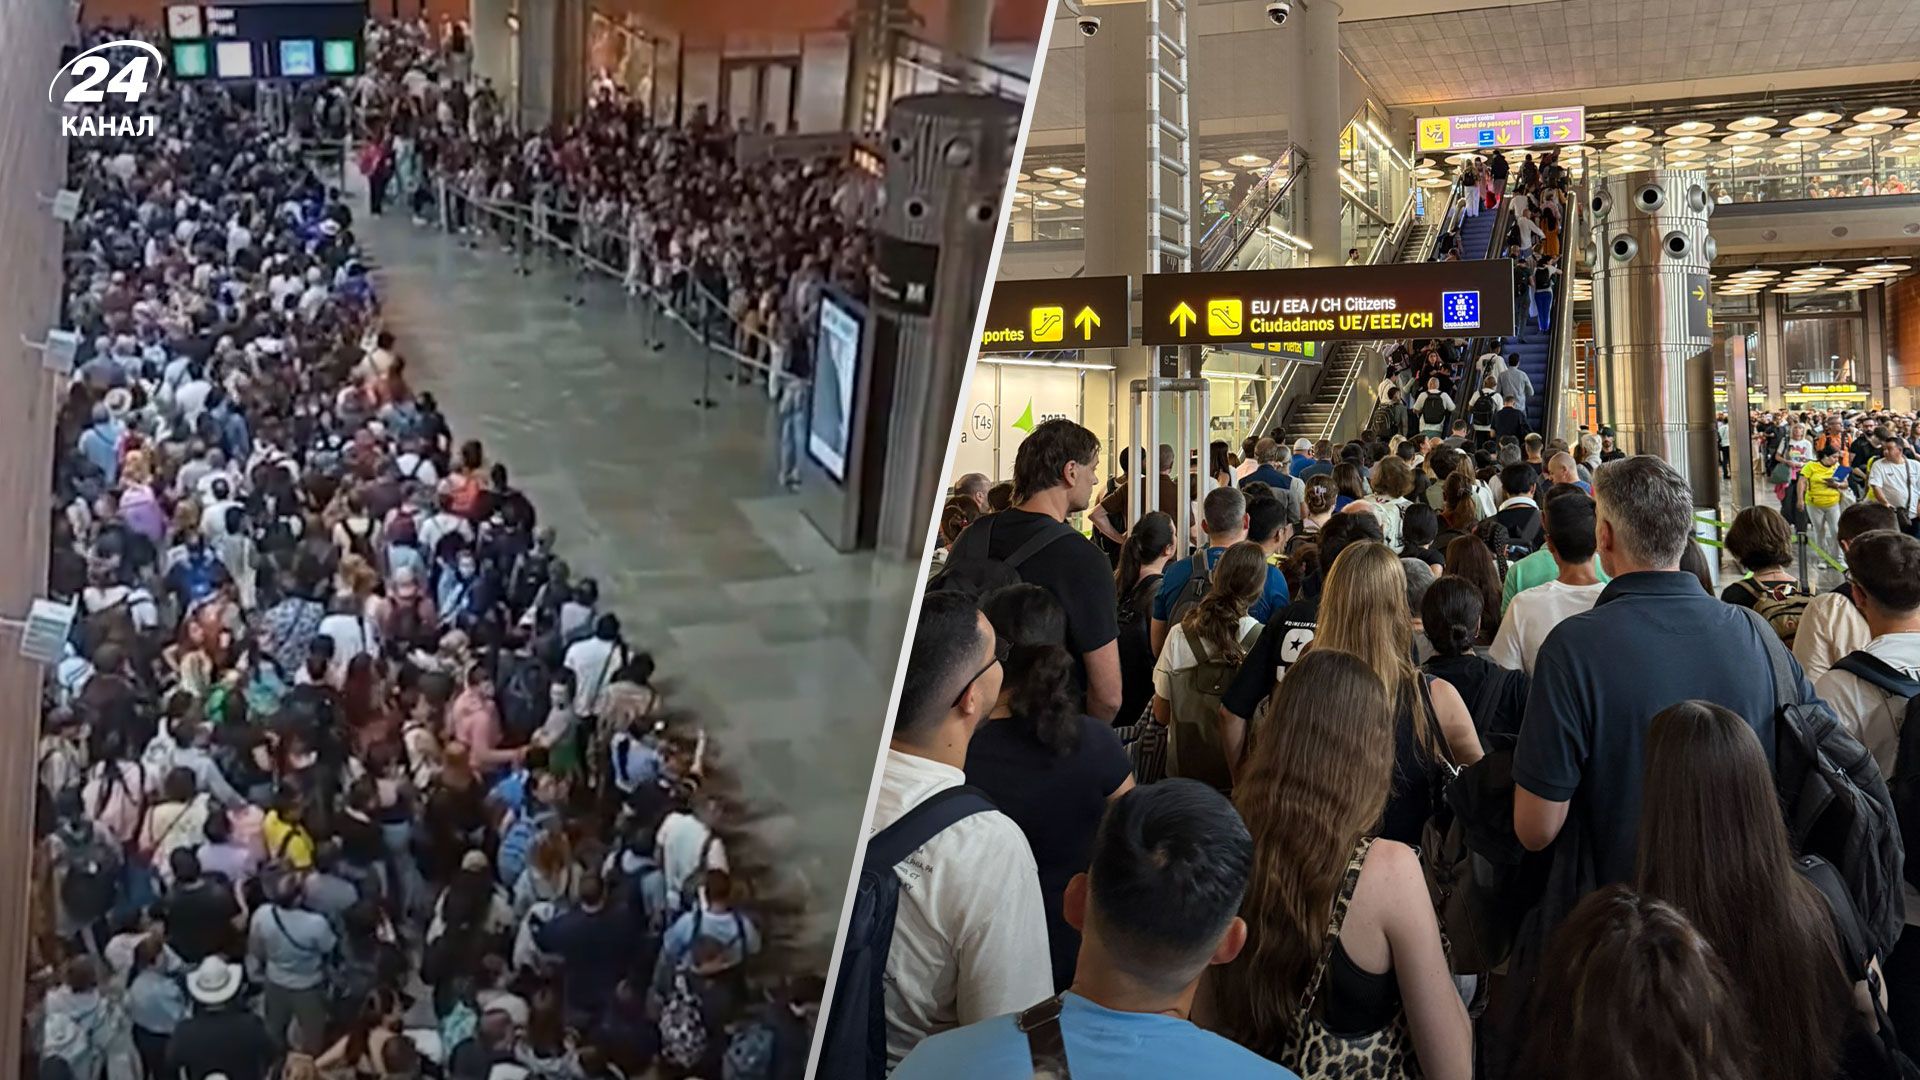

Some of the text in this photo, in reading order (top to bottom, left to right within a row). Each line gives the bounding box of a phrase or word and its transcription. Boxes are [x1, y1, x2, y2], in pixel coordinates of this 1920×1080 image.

[1252, 300, 1270, 315] EU
[1283, 299, 1309, 313] EEA
[1321, 298, 1341, 312] CH
[1345, 297, 1396, 311] Citizens
[1250, 312, 1433, 333] Ciudadanos UE/EEE/CH
[974, 416, 992, 430] T4s
